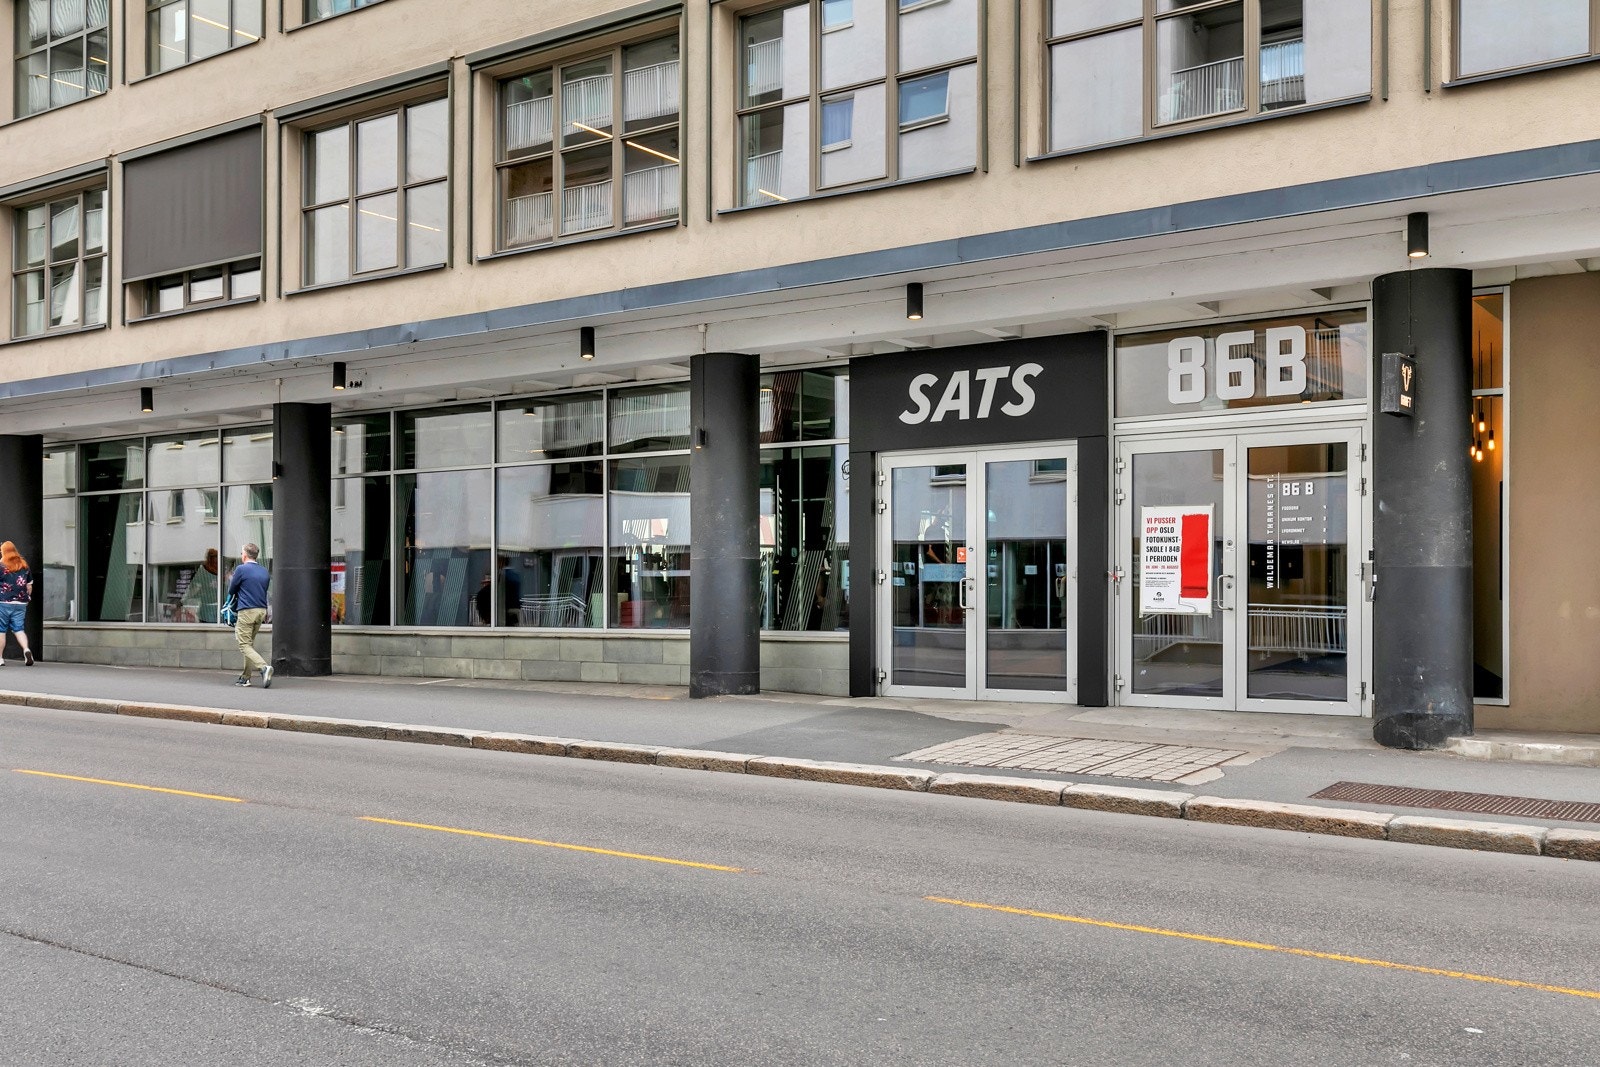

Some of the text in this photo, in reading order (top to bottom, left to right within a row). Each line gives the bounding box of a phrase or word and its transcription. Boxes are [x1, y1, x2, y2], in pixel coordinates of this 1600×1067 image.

[898, 362, 1044, 424] SATS
[1168, 326, 1306, 404] 86B
[1282, 482, 1314, 496] 86 B
